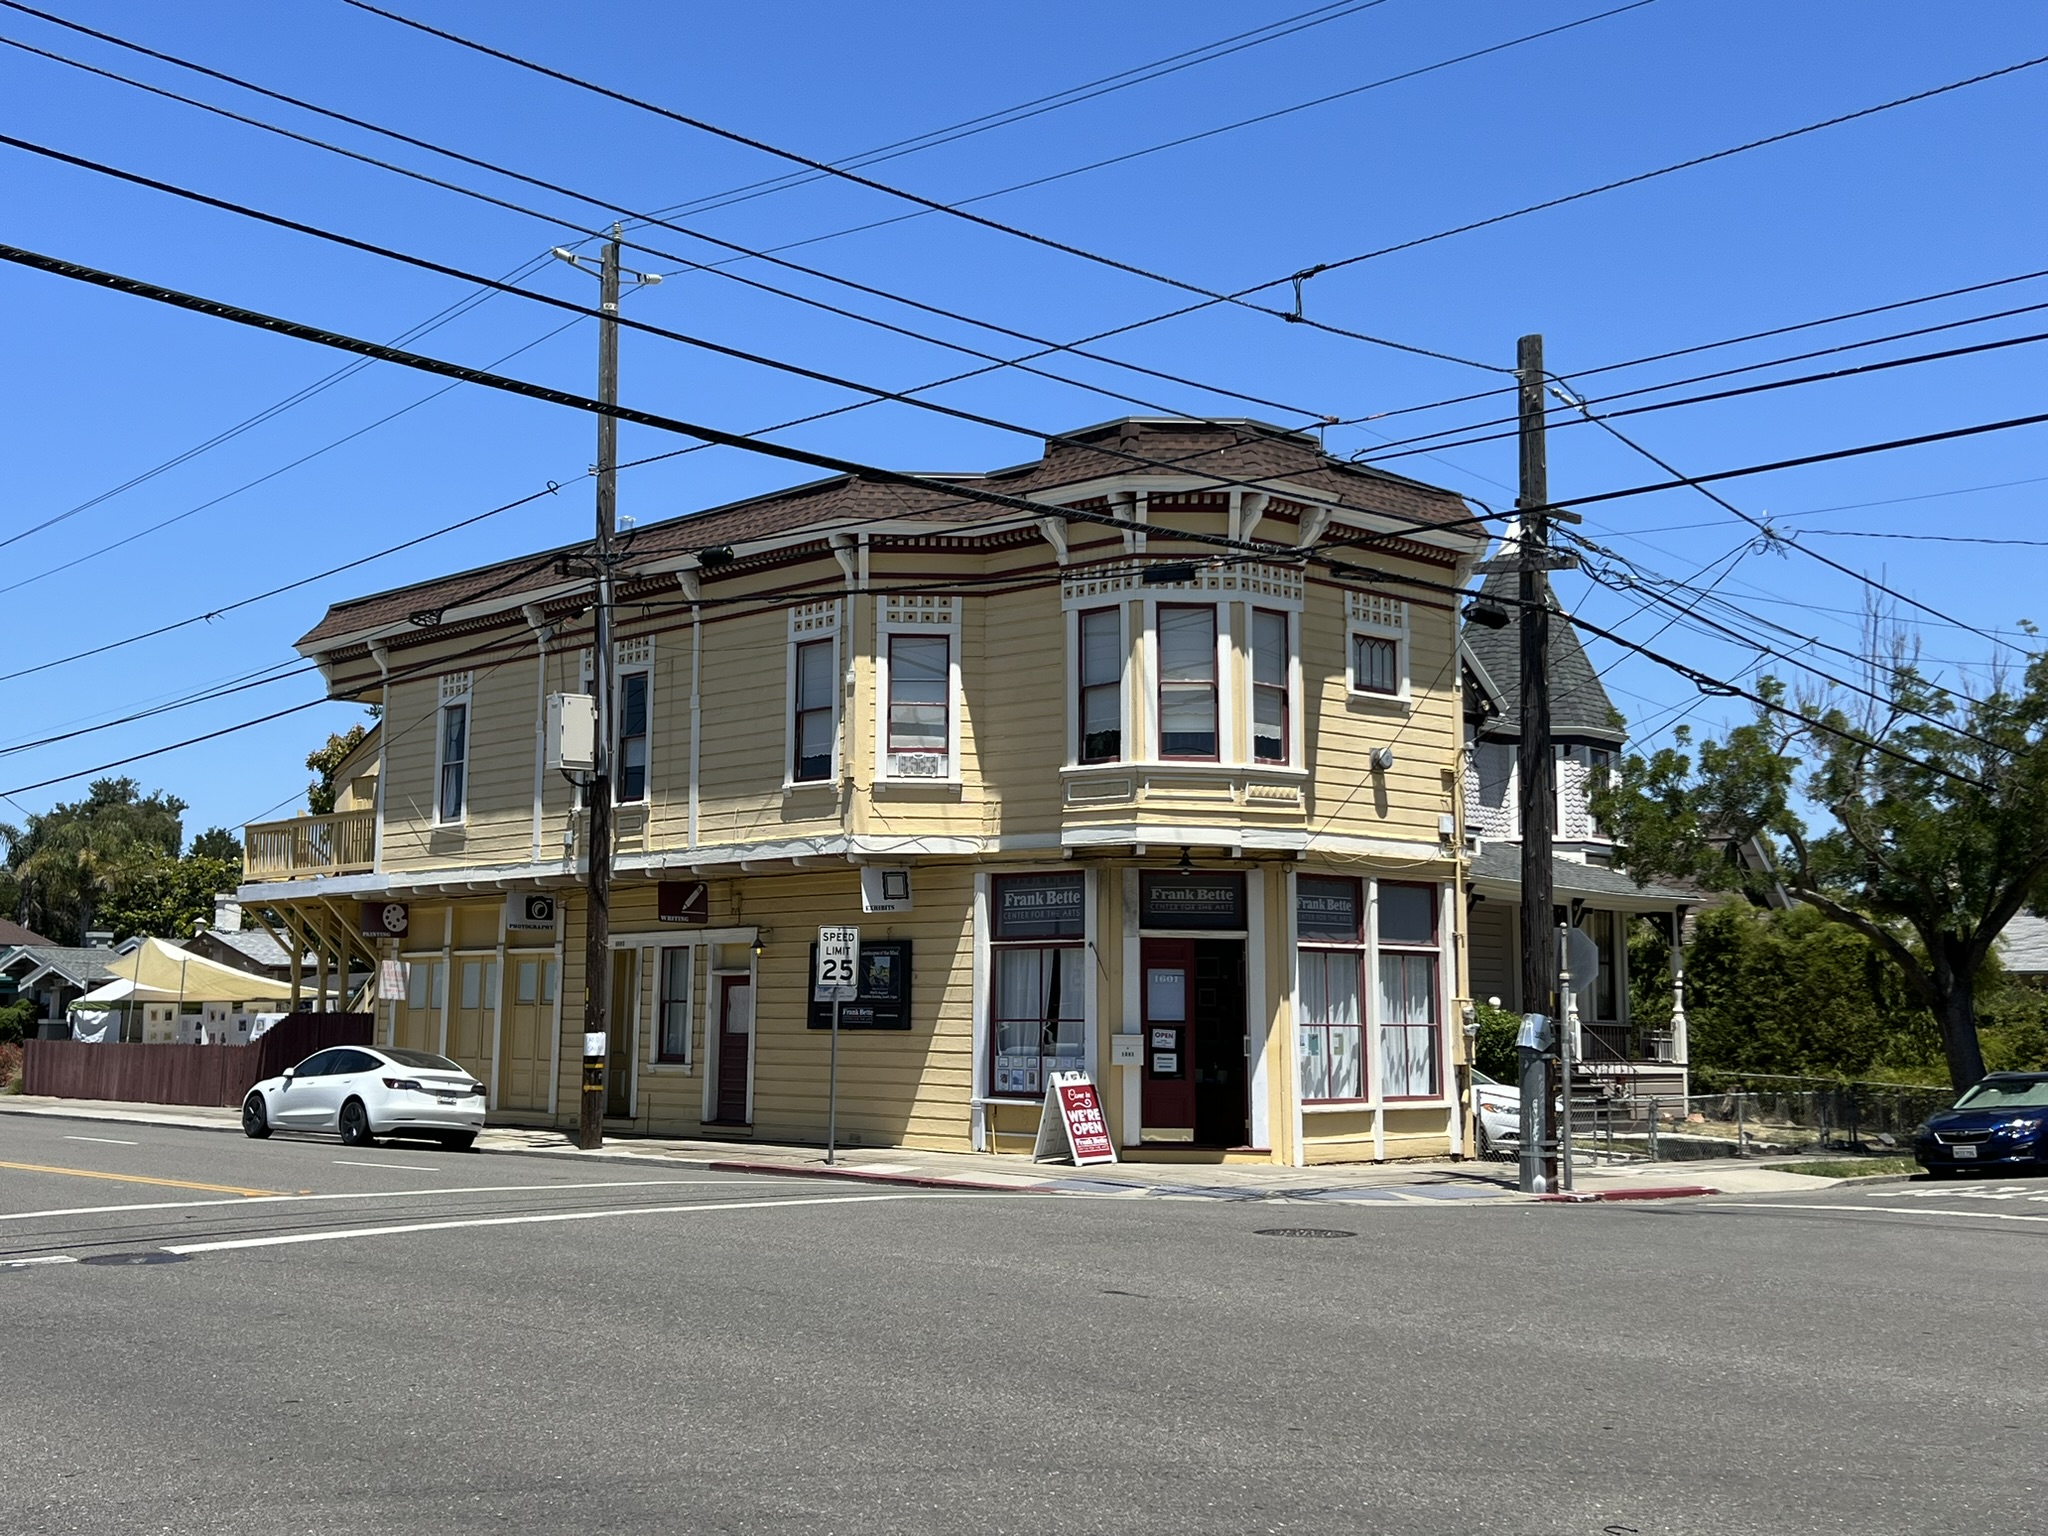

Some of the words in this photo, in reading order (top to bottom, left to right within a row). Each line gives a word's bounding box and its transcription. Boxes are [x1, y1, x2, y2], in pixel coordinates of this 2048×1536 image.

[1004, 892, 1044, 906] Frank
[1046, 890, 1080, 904] Bette
[1150, 889, 1194, 900] Frank
[1196, 889, 1234, 900] Bette
[1297, 898, 1325, 910] Frank
[1327, 899, 1352, 911] Bette
[1003, 911, 1028, 920] CENTER
[1031, 910, 1044, 918] FOR
[1062, 909, 1080, 917] ARTS
[823, 932, 855, 942] SPEED
[826, 946, 851, 956] LIMIT
[822, 960, 853, 981] 25
[1154, 975, 1178, 983] 1601
[1067, 1108, 1101, 1122] WE'RE
[1072, 1122, 1103, 1135] OPEN
